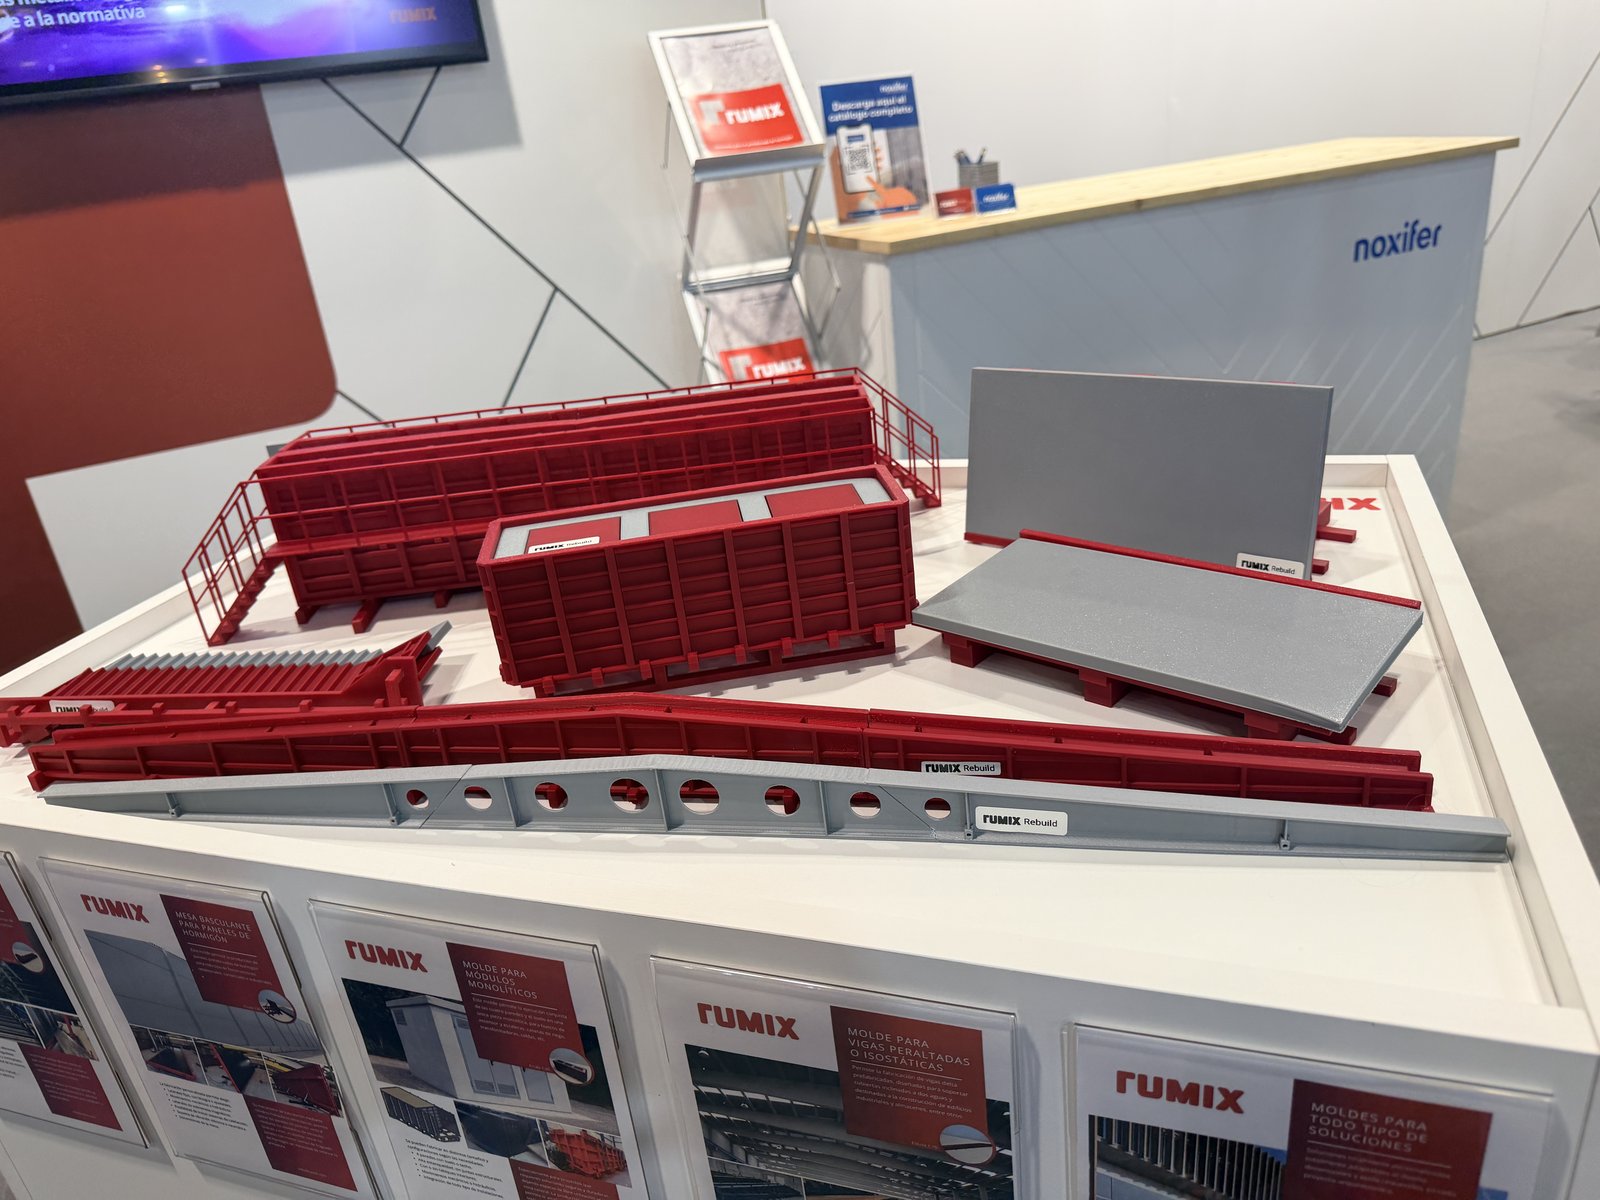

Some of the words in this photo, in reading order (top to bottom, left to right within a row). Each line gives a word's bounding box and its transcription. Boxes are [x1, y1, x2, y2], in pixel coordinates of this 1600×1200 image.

[23, 15, 35, 27] a
[36, 10, 55, 26] la
[57, 5, 145, 25] normativa
[1353, 219, 1442, 262] noxifer
[1271, 565, 1295, 575] Rebuild
[963, 764, 995, 772] Rebuild
[1024, 818, 1058, 827] Rebuild
[175, 912, 197, 921] MESA
[199, 916, 252, 932] BASCULANTE
[179, 920, 200, 930] PARA
[201, 925, 237, 937] PANELES
[239, 931, 251, 939] DE
[182, 929, 227, 943] HORMIGÓN
[462, 960, 498, 973] MOLDE
[501, 967, 527, 979] PARA
[465, 970, 515, 986] MÓDULOS
[468, 980, 538, 999] MONOLÍTICOS
[848, 1027, 892, 1042] MOLDE
[896, 1035, 930, 1049] PARA
[848, 1038, 885, 1051] VIGAS
[889, 1045, 971, 1066] PERALTADAS
[850, 1049, 859, 1057] O
[863, 1051, 944, 1072] ISOSTÁTICAS
[1311, 1102, 1378, 1123] MOLDES
[1384, 1116, 1427, 1131] PARA
[1310, 1114, 1356, 1130] TODO
[1362, 1124, 1400, 1139] TIPO
[1406, 1132, 1428, 1144] DE
[1308, 1126, 1412, 1153] SOLUCIONES
